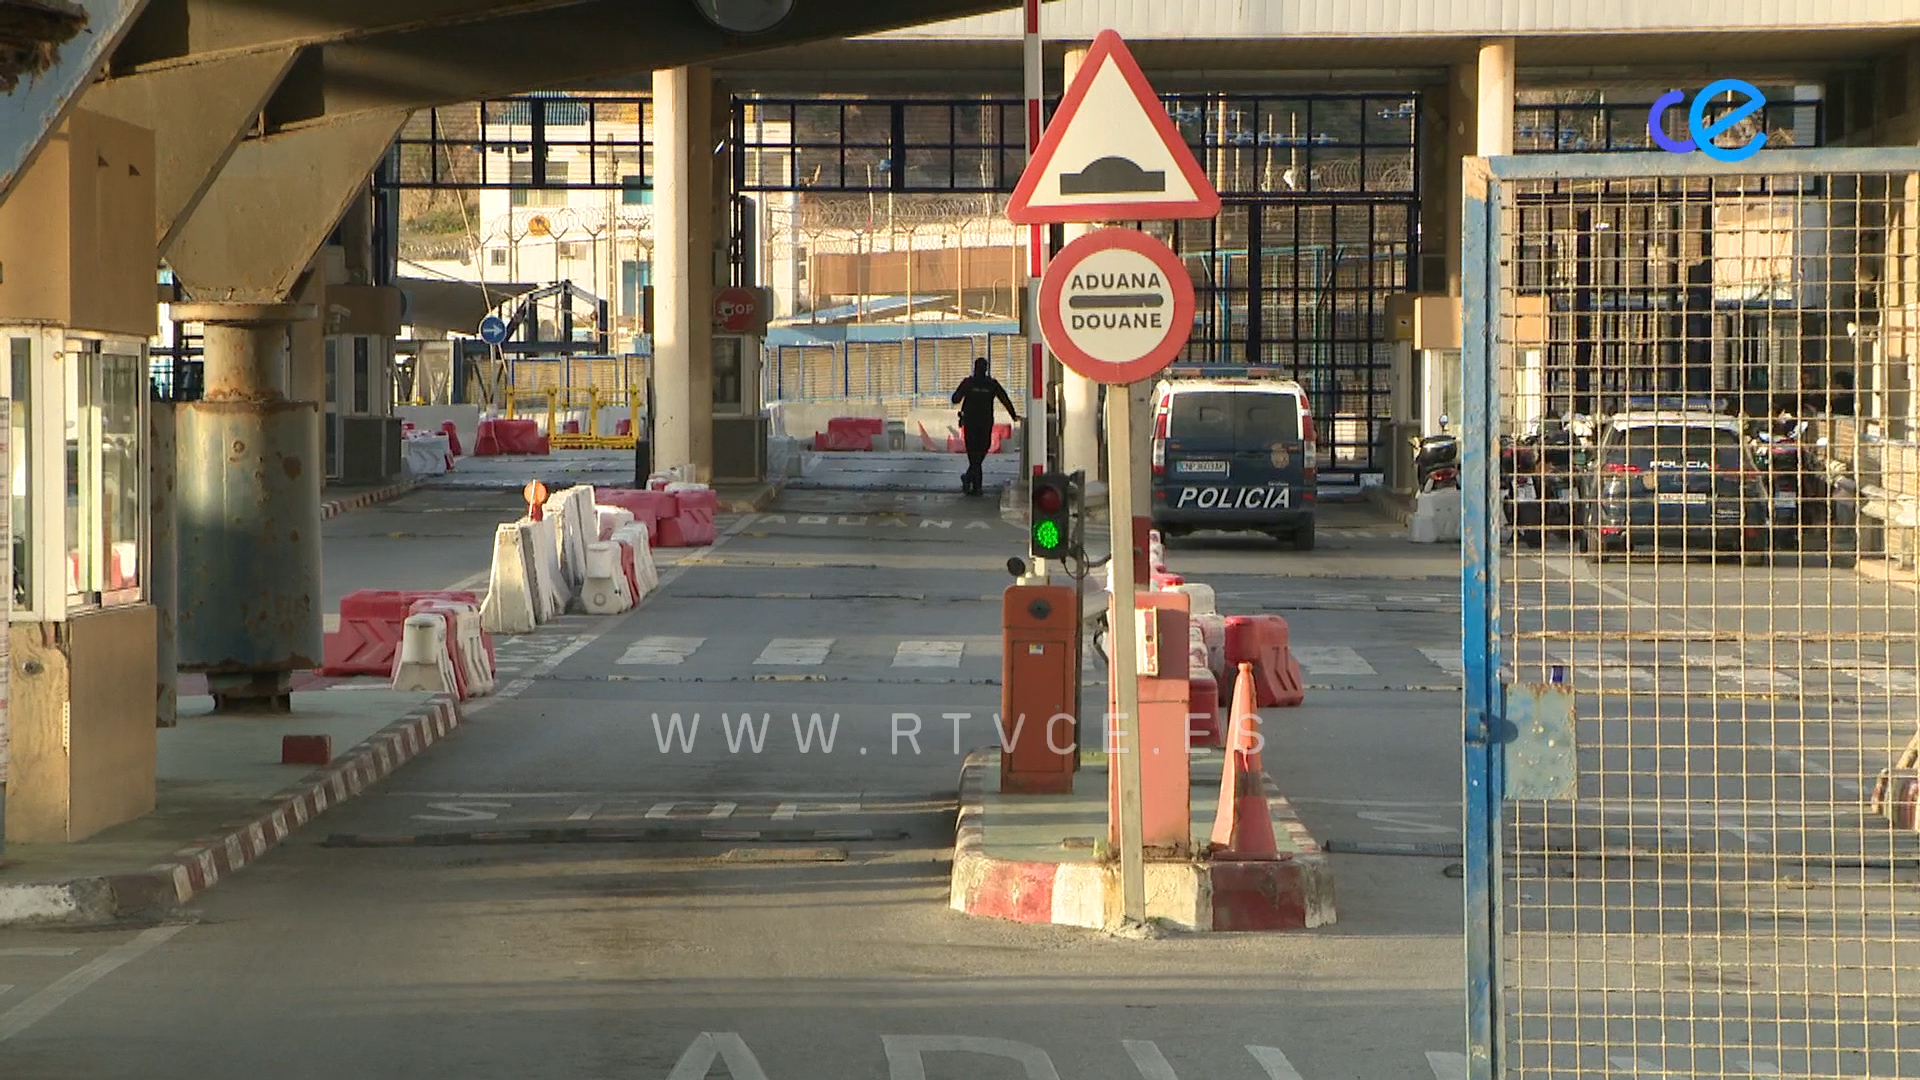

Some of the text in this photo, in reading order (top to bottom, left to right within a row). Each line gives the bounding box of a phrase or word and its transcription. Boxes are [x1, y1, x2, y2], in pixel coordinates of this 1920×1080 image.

[1071, 272, 1161, 290] ADUANA
[1071, 312, 1162, 330] DOUANE
[1649, 460, 1711, 470] POLCIA
[1177, 486, 1291, 509] POLICIA
[757, 514, 991, 530] ADUANA
